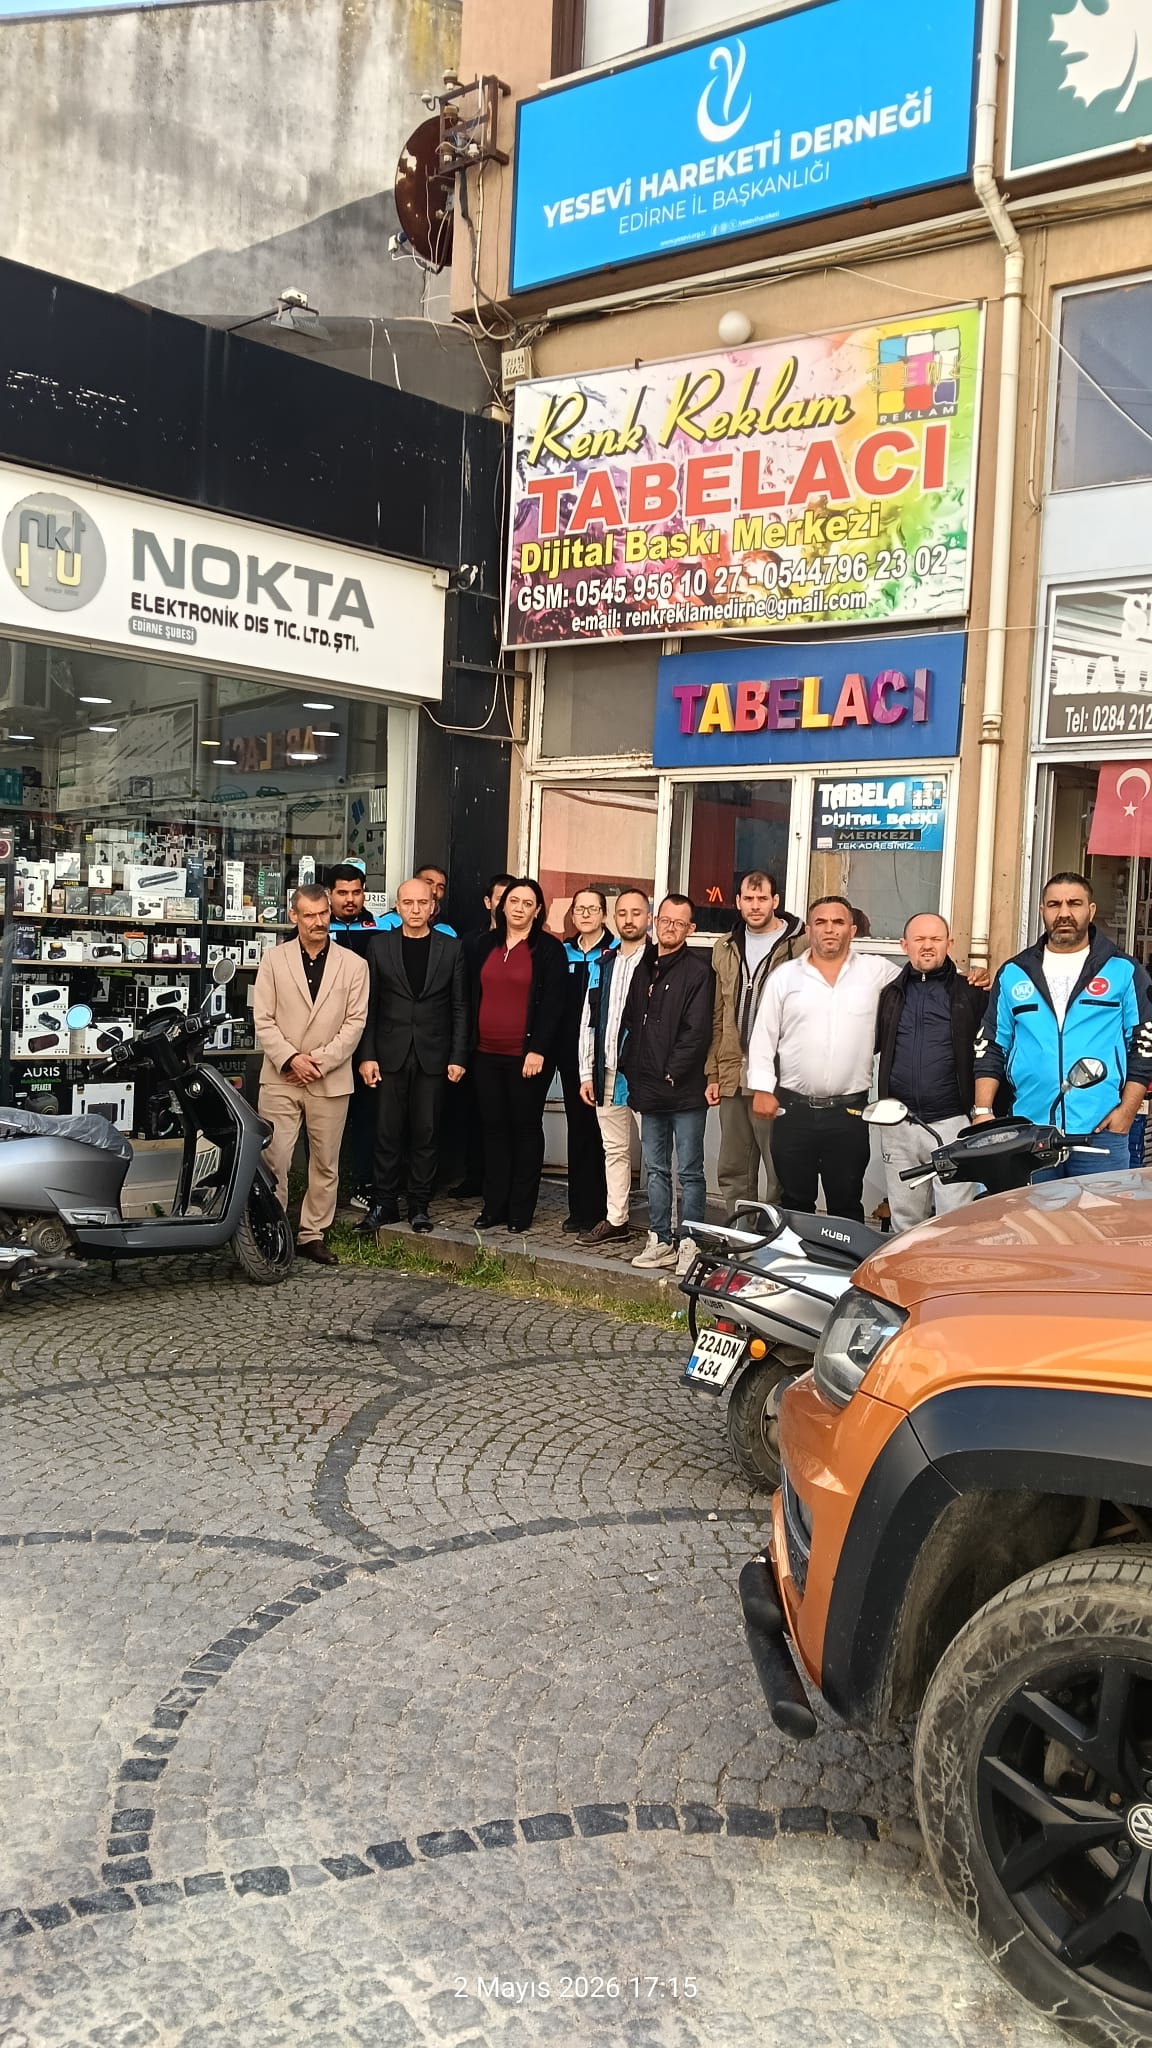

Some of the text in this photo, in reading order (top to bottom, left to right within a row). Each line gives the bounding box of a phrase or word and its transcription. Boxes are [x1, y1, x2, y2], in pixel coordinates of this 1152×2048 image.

[543, 86, 933, 228] YESEVİ HAREKETİ DERNEĞİ
[618, 160, 831, 235] EDİRNE İL BAŞKANLIĞI
[527, 356, 855, 467] Renk Reklam
[880, 406, 955, 423] REKLAM
[528, 424, 948, 536] TABELACI
[520, 502, 881, 579] Dijital Baskı Merkezi
[132, 528, 375, 629] NOKTA
[518, 583, 569, 612] GSM:
[576, 576, 627, 607] 0545
[633, 572, 673, 602] 956
[680, 568, 707, 598] 10
[714, 565, 743, 594] 27
[874, 548, 907, 580] 23
[915, 544, 948, 576] 02
[131, 591, 239, 629] ELEKTRONİK
[303, 626, 331, 647] LTD.
[572, 590, 867, 632] e-mail: renkreklamedirne@gmail.com
[132, 619, 194, 641] EDİRNE ŞUBESİ
[671, 668, 931, 735] TABELACI
[1065, 703, 1152, 733] Tel: 0284 212
[819, 782, 905, 810] TABELA
[821, 812, 938, 827] DİJİTAL BASKI
[839, 831, 915, 840] MERKEZİ
[365, 894, 386, 902] URIS
[22, 1066, 60, 1077] AURIS
[821, 1228, 851, 1243] KUBA
[697, 1359, 722, 1378] 434
